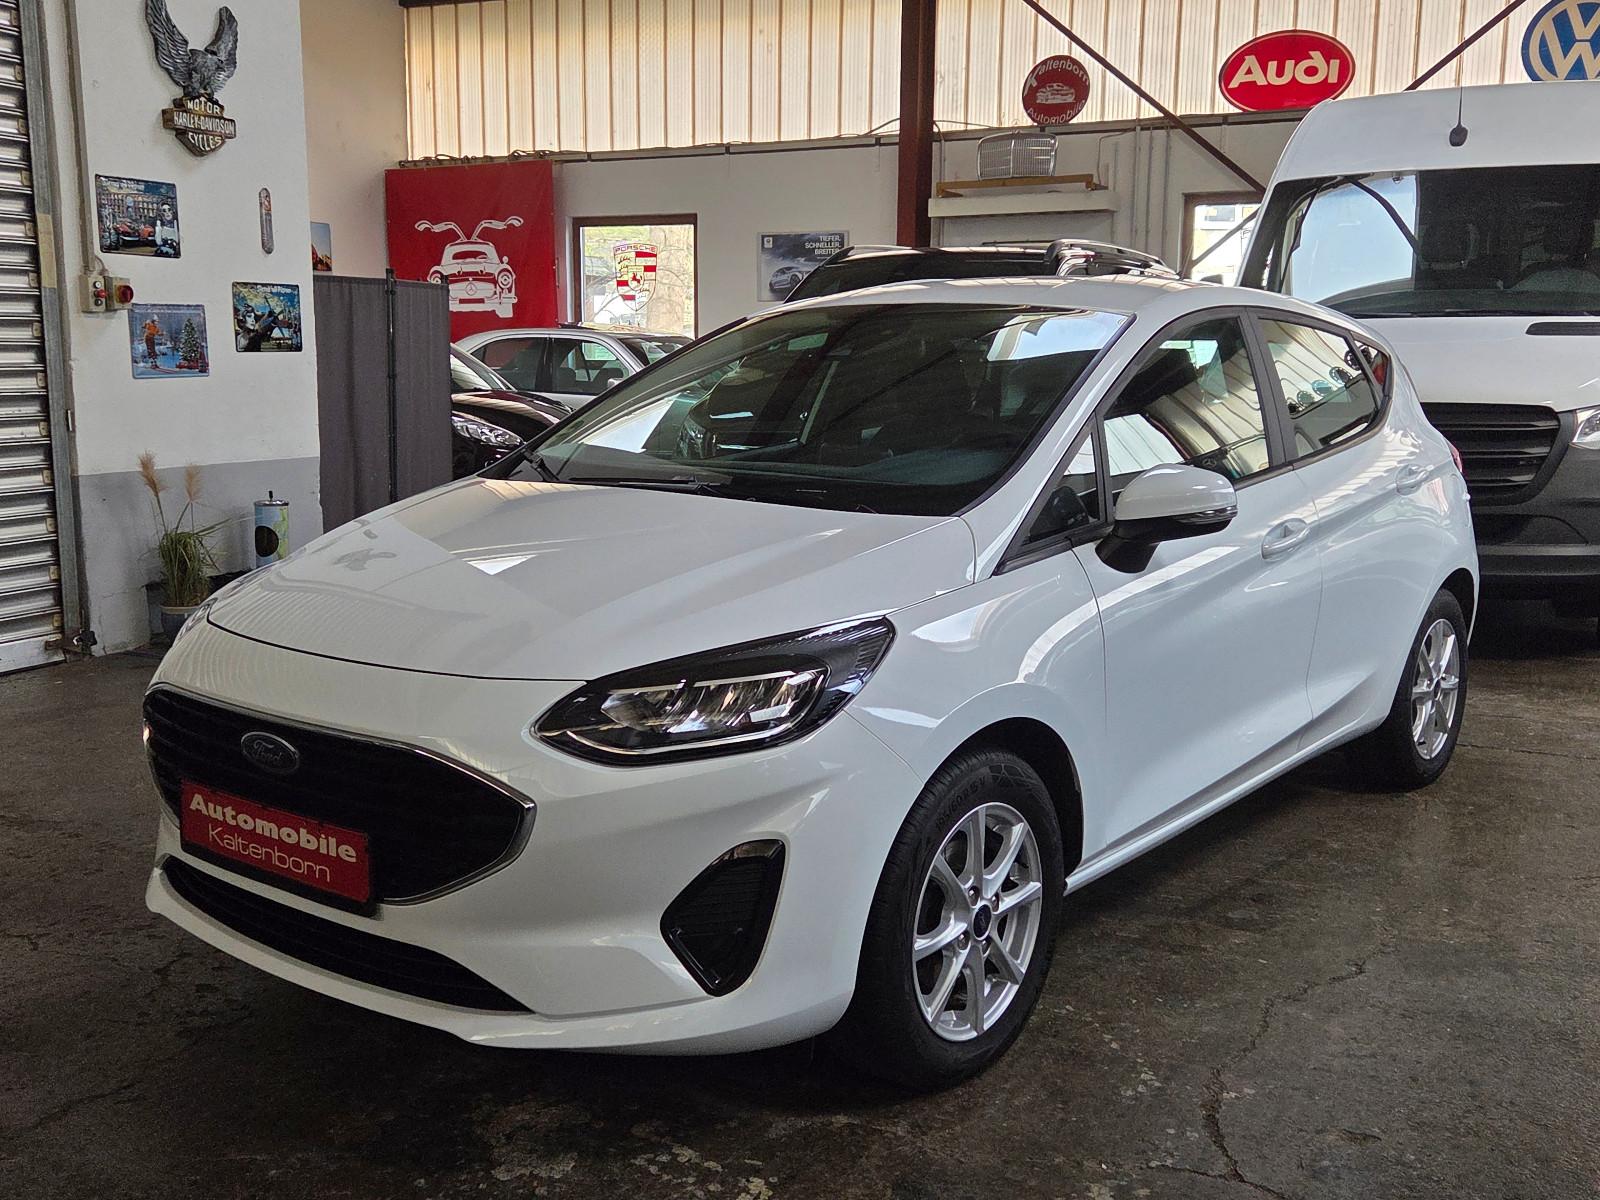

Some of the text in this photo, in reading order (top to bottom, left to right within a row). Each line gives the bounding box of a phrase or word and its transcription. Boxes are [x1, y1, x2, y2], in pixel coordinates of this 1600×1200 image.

[1023, 59, 1089, 97] Kaltenborn
[1228, 51, 1340, 89] Audi
[174, 111, 235, 135] HARLEY-DAVIDSON
[187, 97, 220, 115] MOTOR
[188, 131, 222, 151] CYCLES
[190, 793, 357, 863] Automobile
[208, 823, 331, 882] Kaltenborn
